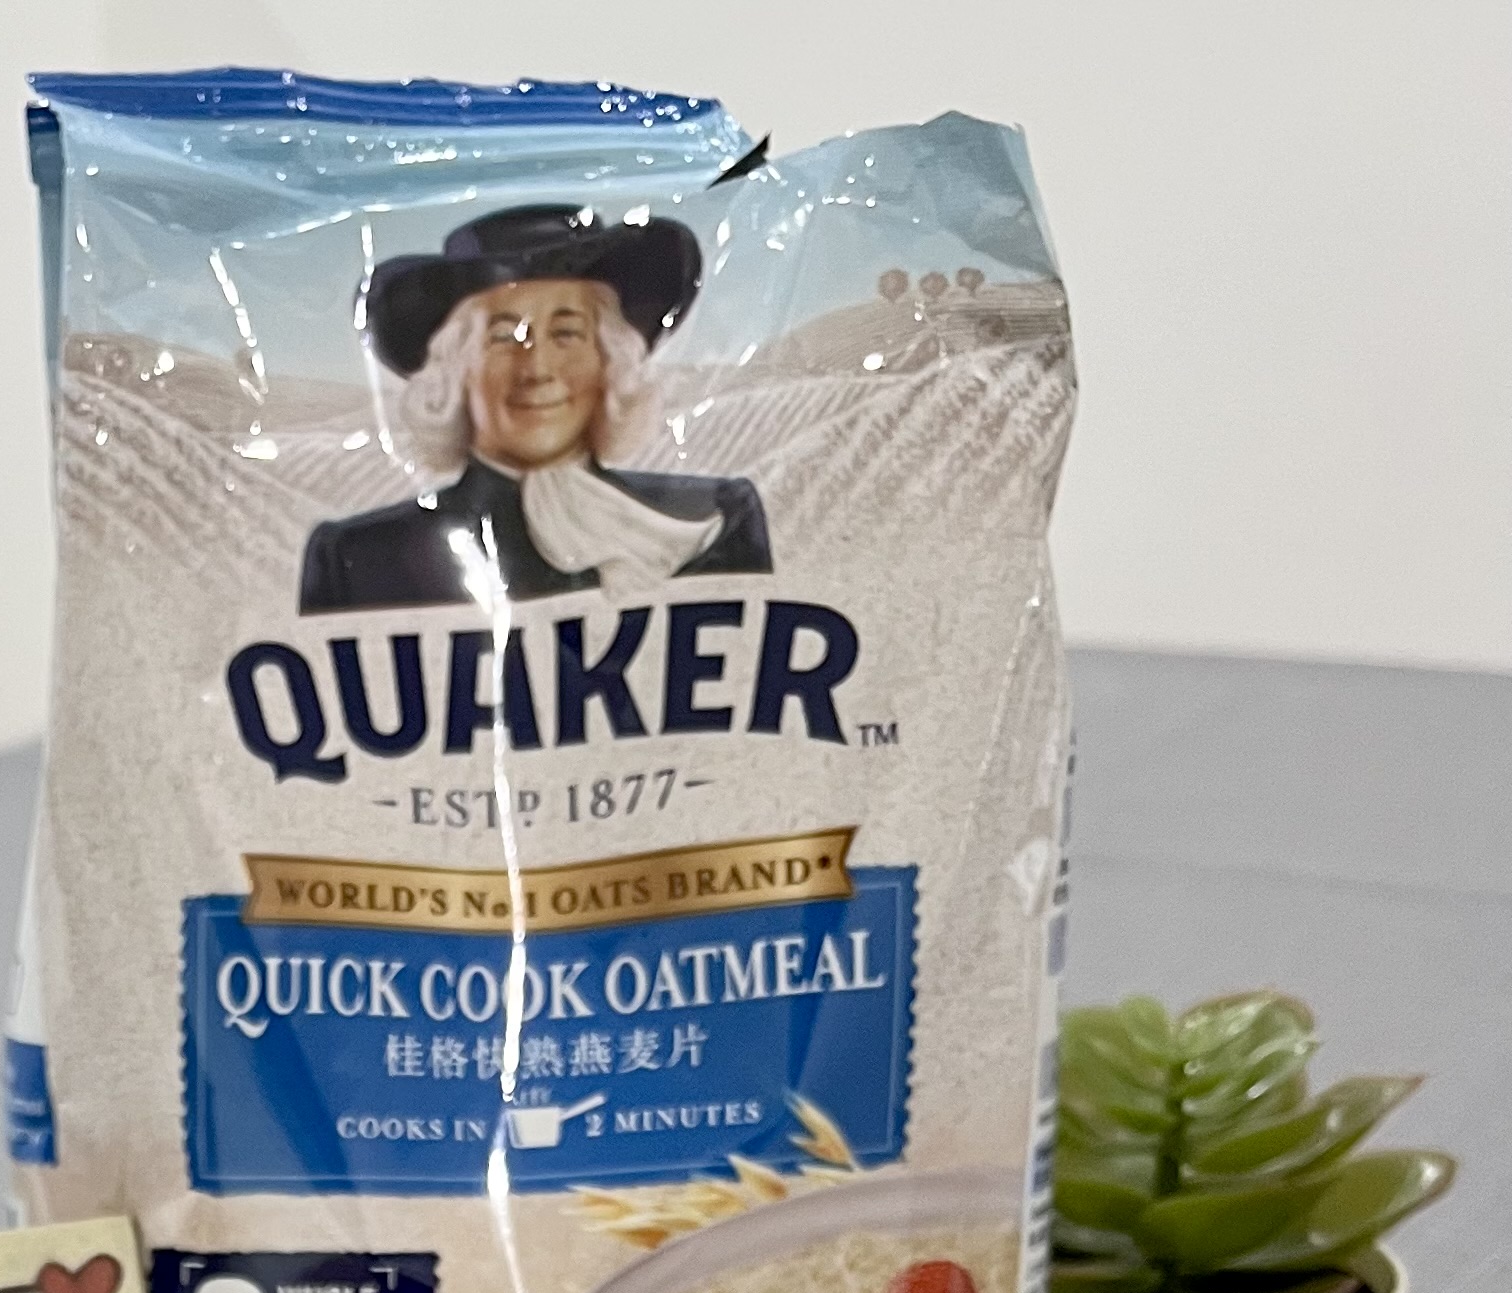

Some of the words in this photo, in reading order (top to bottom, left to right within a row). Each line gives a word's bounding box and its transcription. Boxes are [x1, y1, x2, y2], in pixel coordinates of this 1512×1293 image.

[226, 598, 858, 785] QUAKER
[858, 722, 900, 747] TM
[566, 768, 676, 822] 1877
[276, 878, 449, 924] WORLD'S
[550, 876, 651, 916] OATS
[216, 955, 410, 1039] QUICK
[419, 960, 595, 1023] COOK
[602, 930, 887, 1016] OATMEAL
[337, 1116, 445, 1141] COOKS
[454, 1118, 489, 1141] IN
[585, 1112, 604, 1137] 2
[615, 1100, 762, 1134] MINUTES
